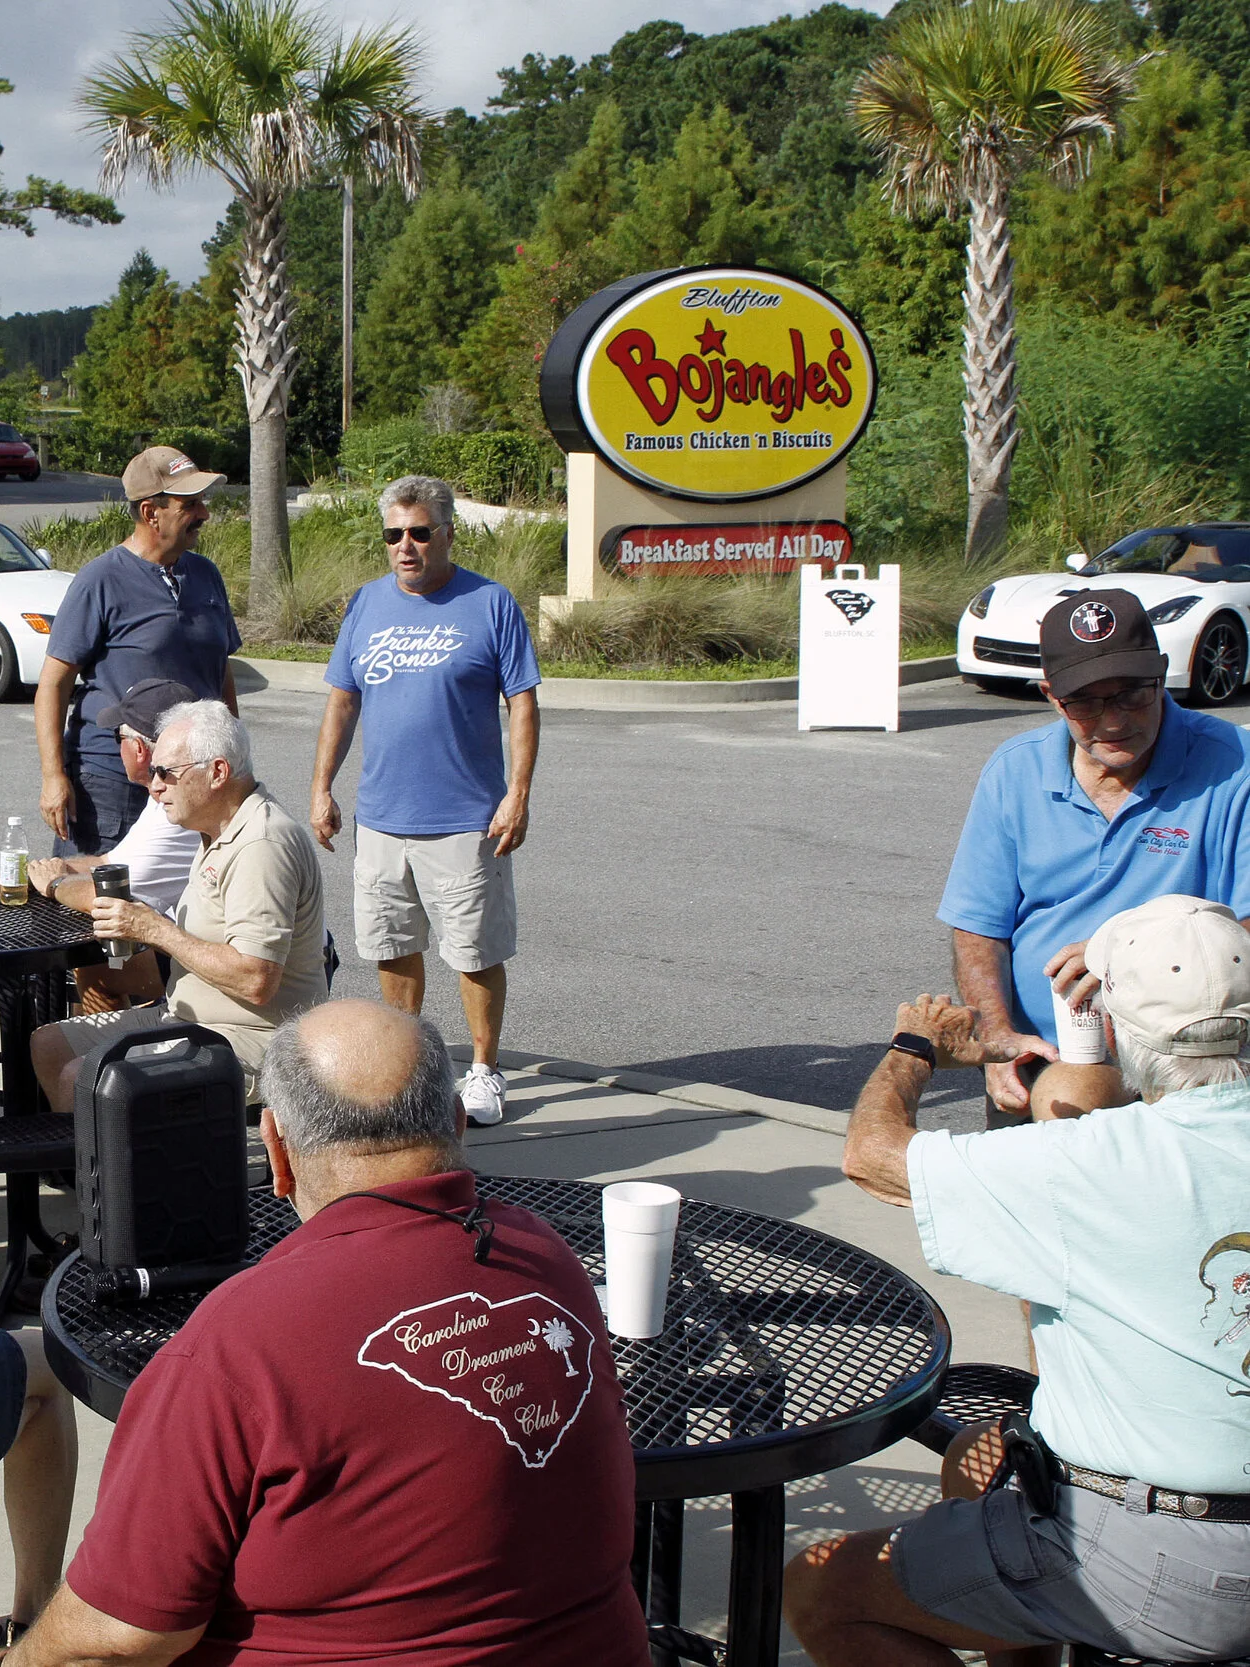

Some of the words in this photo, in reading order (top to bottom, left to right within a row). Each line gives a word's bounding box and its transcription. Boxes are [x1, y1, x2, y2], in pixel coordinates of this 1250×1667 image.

[681, 288, 782, 314] Bluffton
[625, 433, 683, 450] Famous
[690, 431, 750, 449] Chicken
[772, 430, 832, 449] Biscuits
[621, 538, 711, 564] Breakfast
[714, 537, 775, 561] Served
[778, 535, 806, 559] All
[811, 534, 845, 561] Day
[359, 624, 462, 665] Frankie
[364, 650, 450, 685] Bones
[394, 1311, 489, 1354] Carolina
[441, 1338, 537, 1380] Dreamers
[482, 1373, 525, 1406] Car
[514, 1400, 561, 1436] Club
